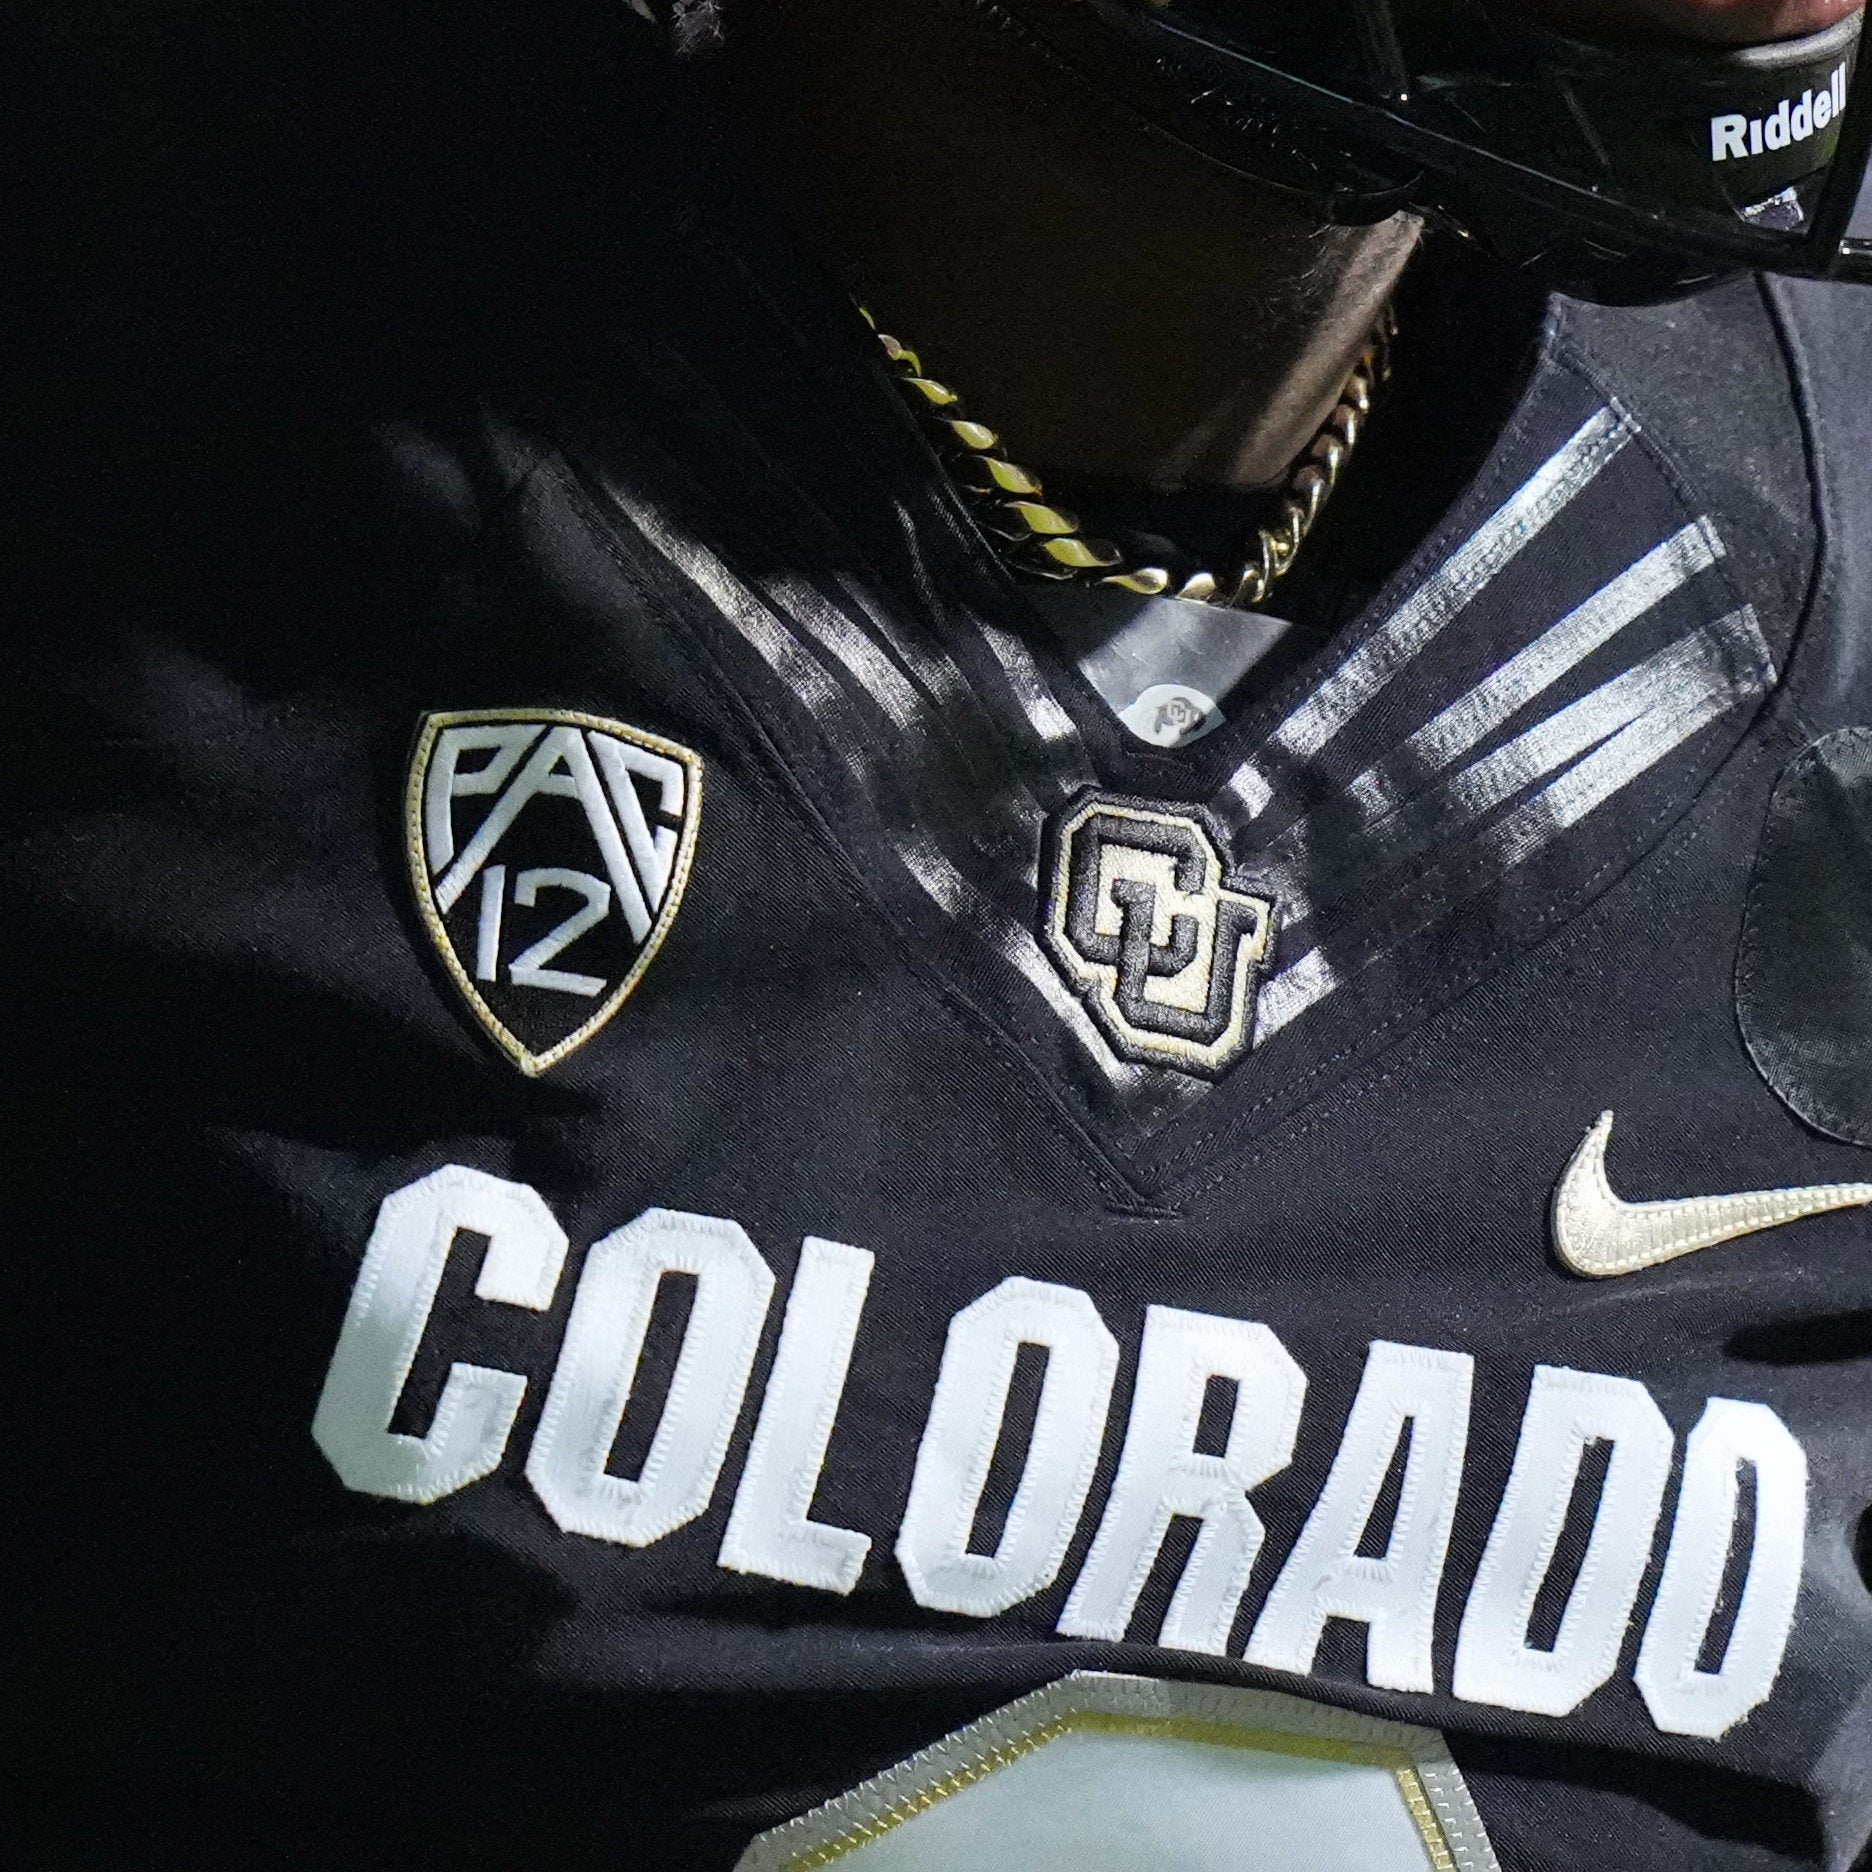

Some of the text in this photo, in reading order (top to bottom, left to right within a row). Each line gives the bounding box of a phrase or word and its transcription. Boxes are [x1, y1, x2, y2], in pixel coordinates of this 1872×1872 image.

[1710, 61, 1847, 162] Riddell
[427, 725, 685, 945] PAC
[476, 863, 612, 998] 12
[311, 1163, 1808, 1740] COLORADO
